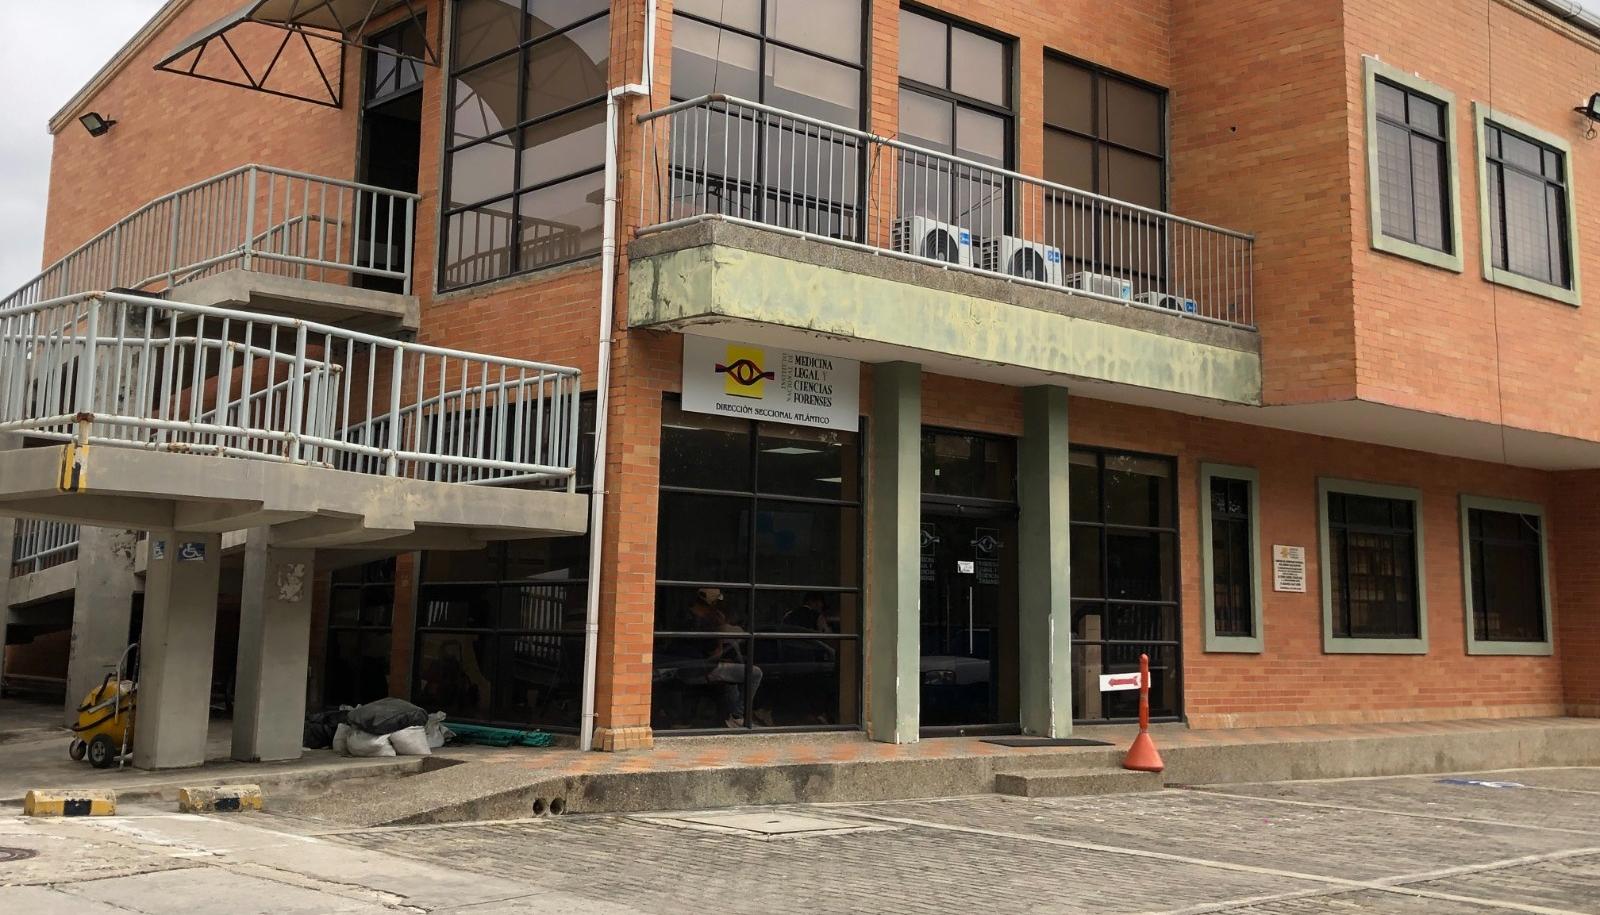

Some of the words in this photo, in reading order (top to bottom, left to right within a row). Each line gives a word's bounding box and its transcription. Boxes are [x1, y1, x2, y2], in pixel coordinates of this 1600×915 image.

[794, 355, 833, 371] MEDICINA
[794, 367, 820, 381] LEGAL
[794, 380, 833, 395] CIENCIAS
[793, 393, 832, 408] FORENSES
[715, 402, 753, 414] DIRECCIÓN
[754, 408, 793, 420] SECCIONAL
[794, 413, 830, 425] ATLÁNTICO
